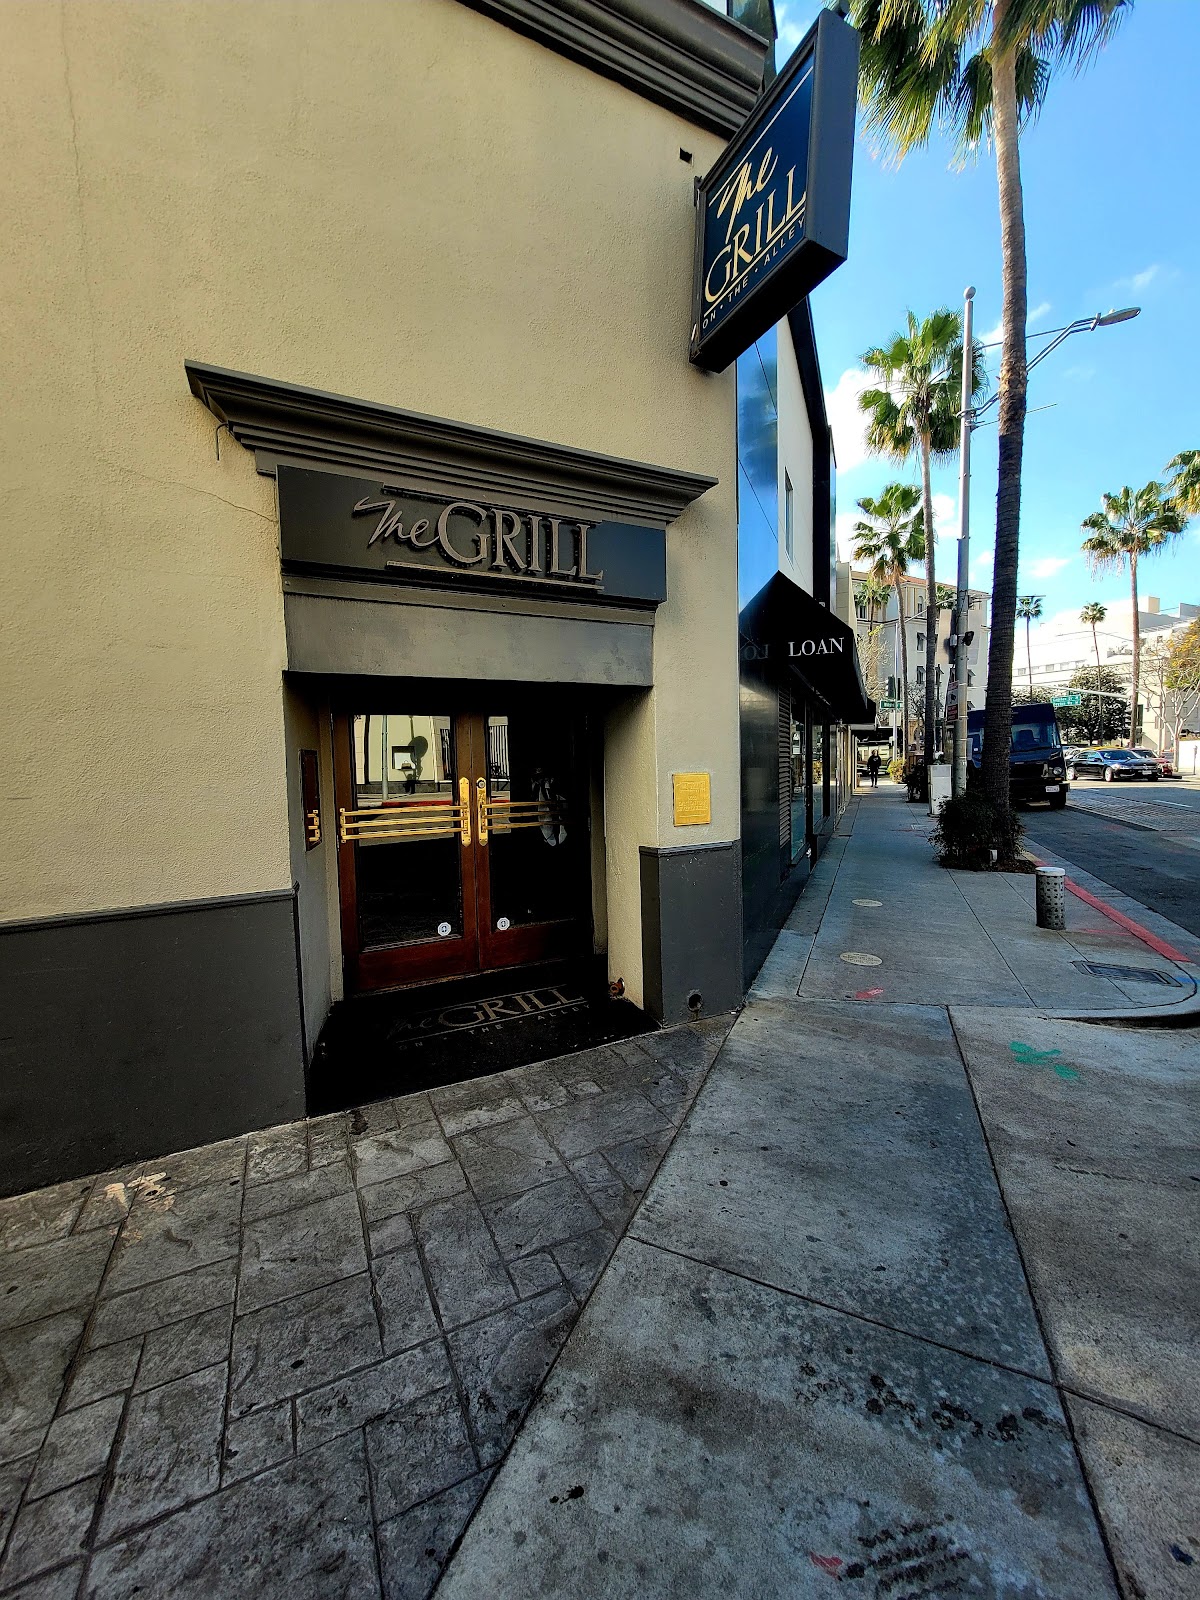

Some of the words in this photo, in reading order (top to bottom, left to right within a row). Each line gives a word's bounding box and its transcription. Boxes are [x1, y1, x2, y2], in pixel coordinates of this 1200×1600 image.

[704, 164, 806, 303] GRILL
[716, 146, 779, 244] The
[702, 309, 717, 330] ON
[727, 277, 749, 304] THE
[763, 216, 805, 264] ALLEY
[353, 496, 440, 547] The
[437, 502, 604, 581] GRILL
[788, 636, 844, 657] LOAN
[437, 988, 585, 1027] GRILL
[468, 1024, 504, 1035] THE
